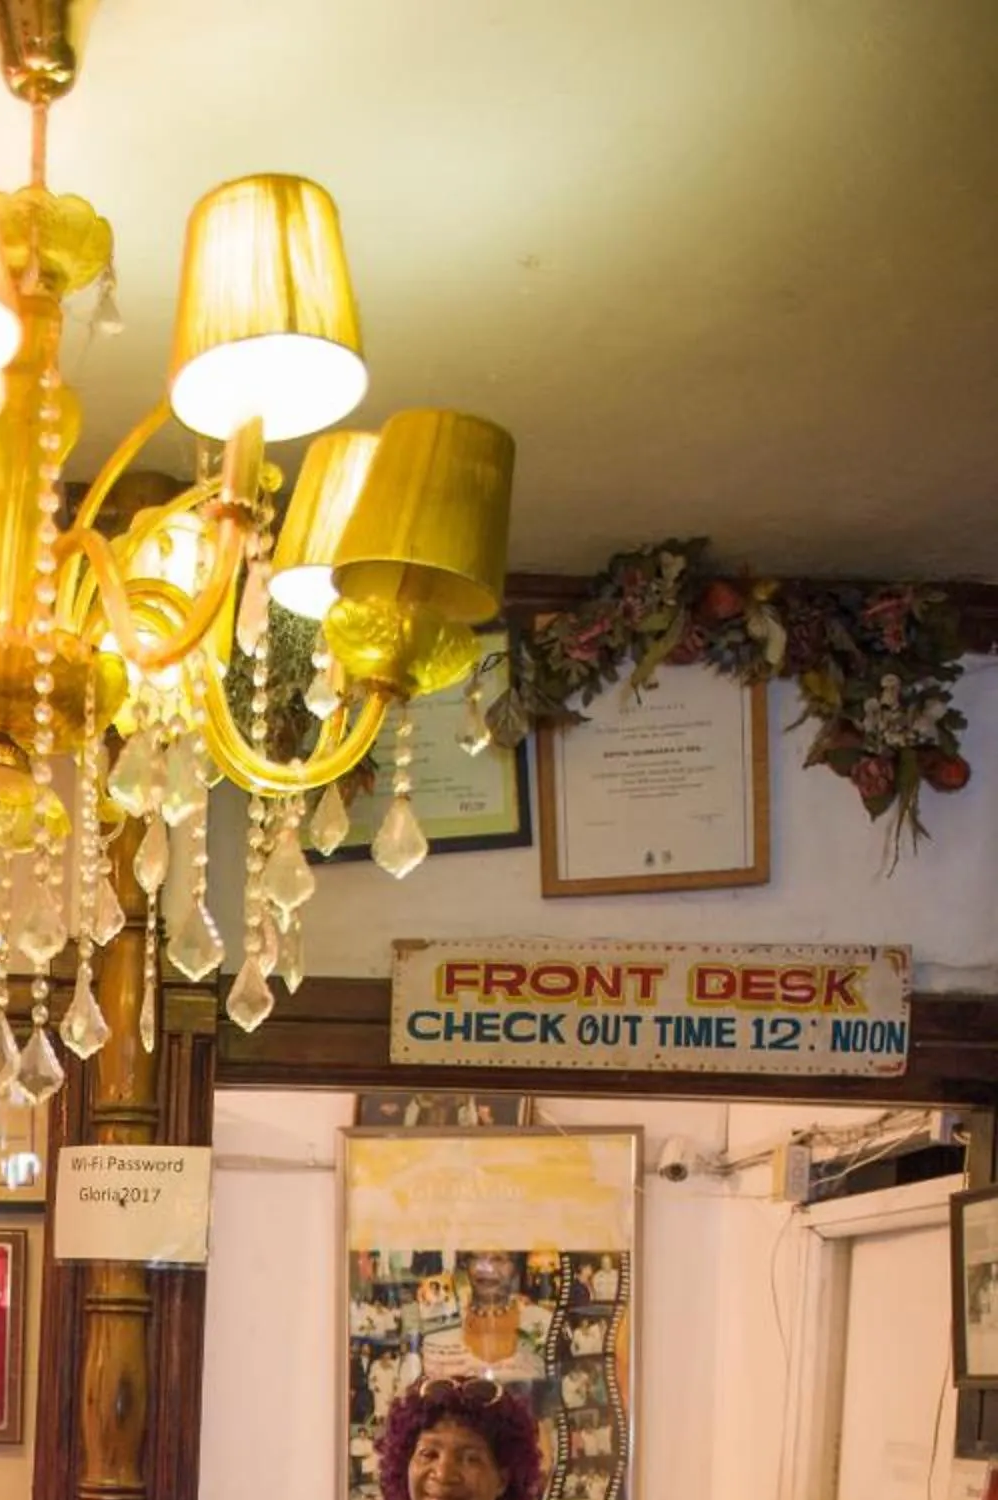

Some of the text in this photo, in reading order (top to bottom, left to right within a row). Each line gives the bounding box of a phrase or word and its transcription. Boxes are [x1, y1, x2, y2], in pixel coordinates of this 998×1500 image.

[436, 960, 868, 1012] FRONT DESK
[406, 1010, 566, 1044] CHECK
[576, 1013, 642, 1046] OUT
[654, 1015, 737, 1049] TIME
[830, 1020, 906, 1055] NOON
[71, 1155, 185, 1173] Wi-Fi Password
[78, 1187, 162, 1203] Gloria2017
